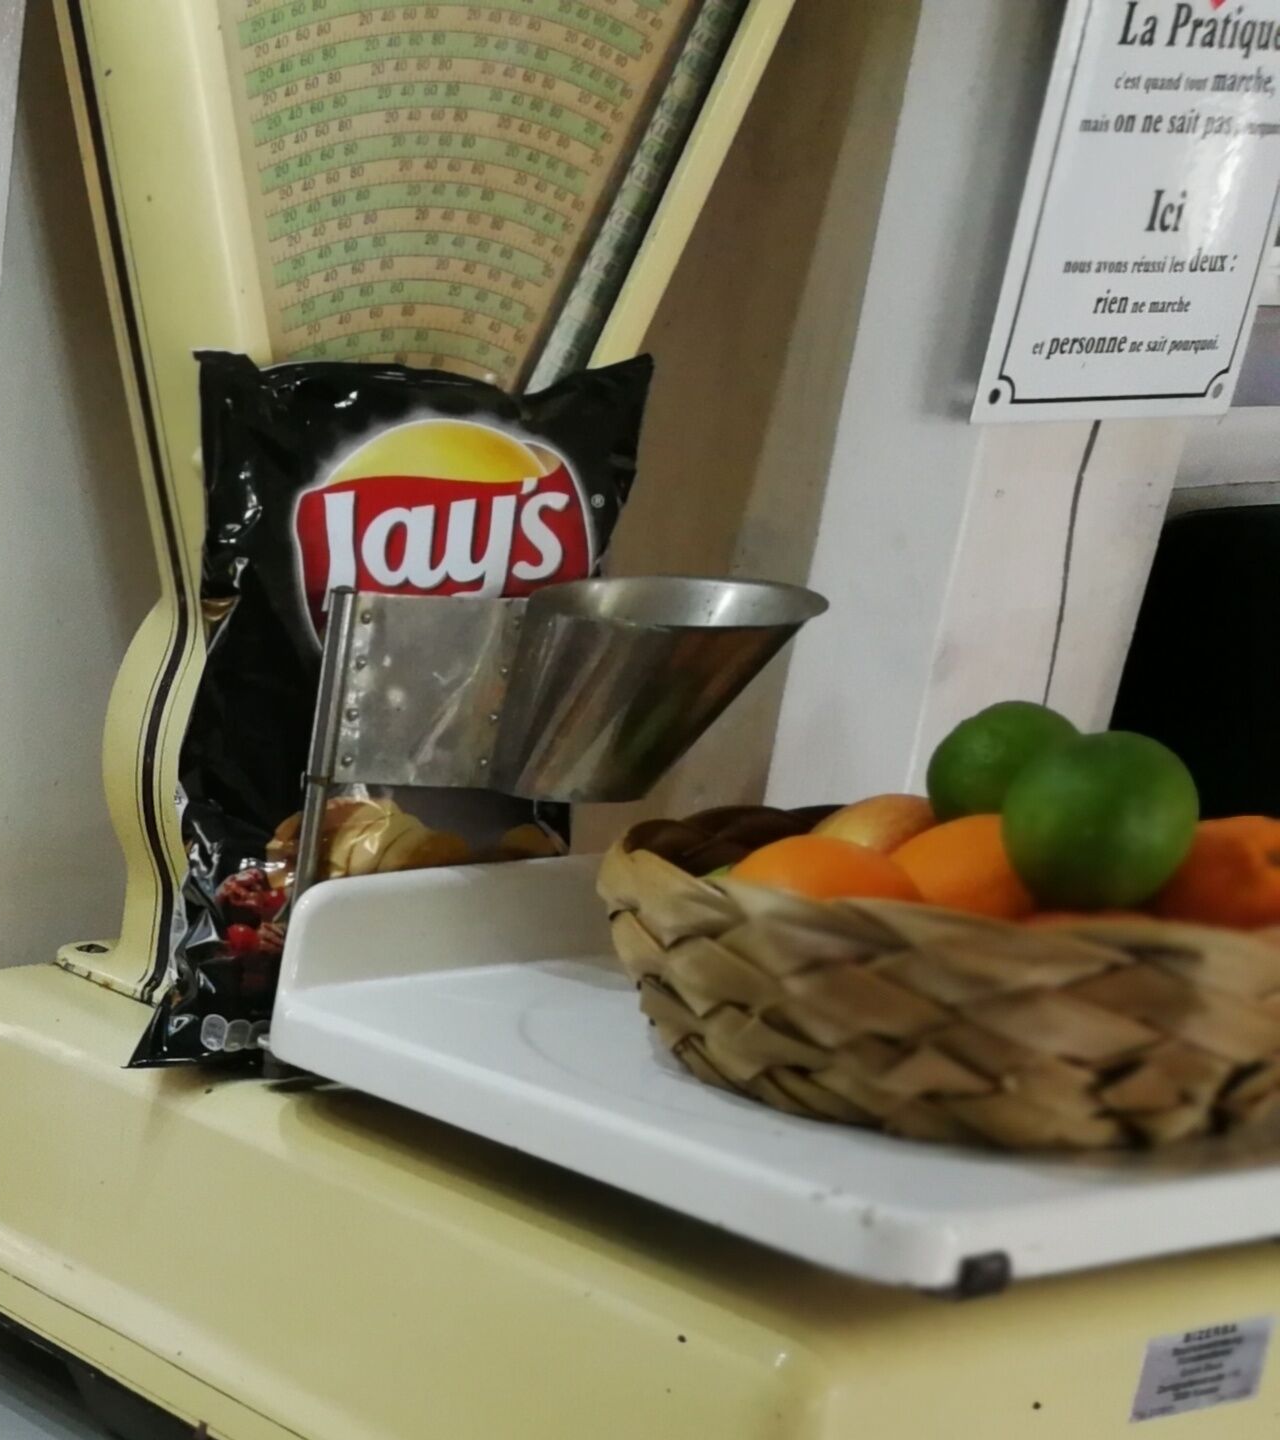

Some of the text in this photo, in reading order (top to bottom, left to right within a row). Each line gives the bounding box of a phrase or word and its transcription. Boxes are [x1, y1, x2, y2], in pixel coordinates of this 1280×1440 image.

[1117, 1, 1158, 47] La
[1144, 73, 1183, 94] quand
[1079, 114, 1110, 132] mais
[1114, 113, 1136, 133] on
[1141, 113, 1163, 133] ne
[1167, 109, 1200, 134] sait
[1144, 189, 1188, 232] Ici
[1063, 258, 1092, 274] nous
[1095, 259, 1128, 274] avons
[1131, 256, 1166, 274] réussi
[1169, 256, 1185, 273] les
[1189, 247, 1228, 272] deux
[1093, 289, 1191, 314] rien ne marche
[1032, 340, 1045, 355] et
[1046, 335, 1128, 360] personne
[1129, 338, 1144, 353] ne
[1145, 335, 1166, 352] sait
[321, 477, 570, 598] Lay's
